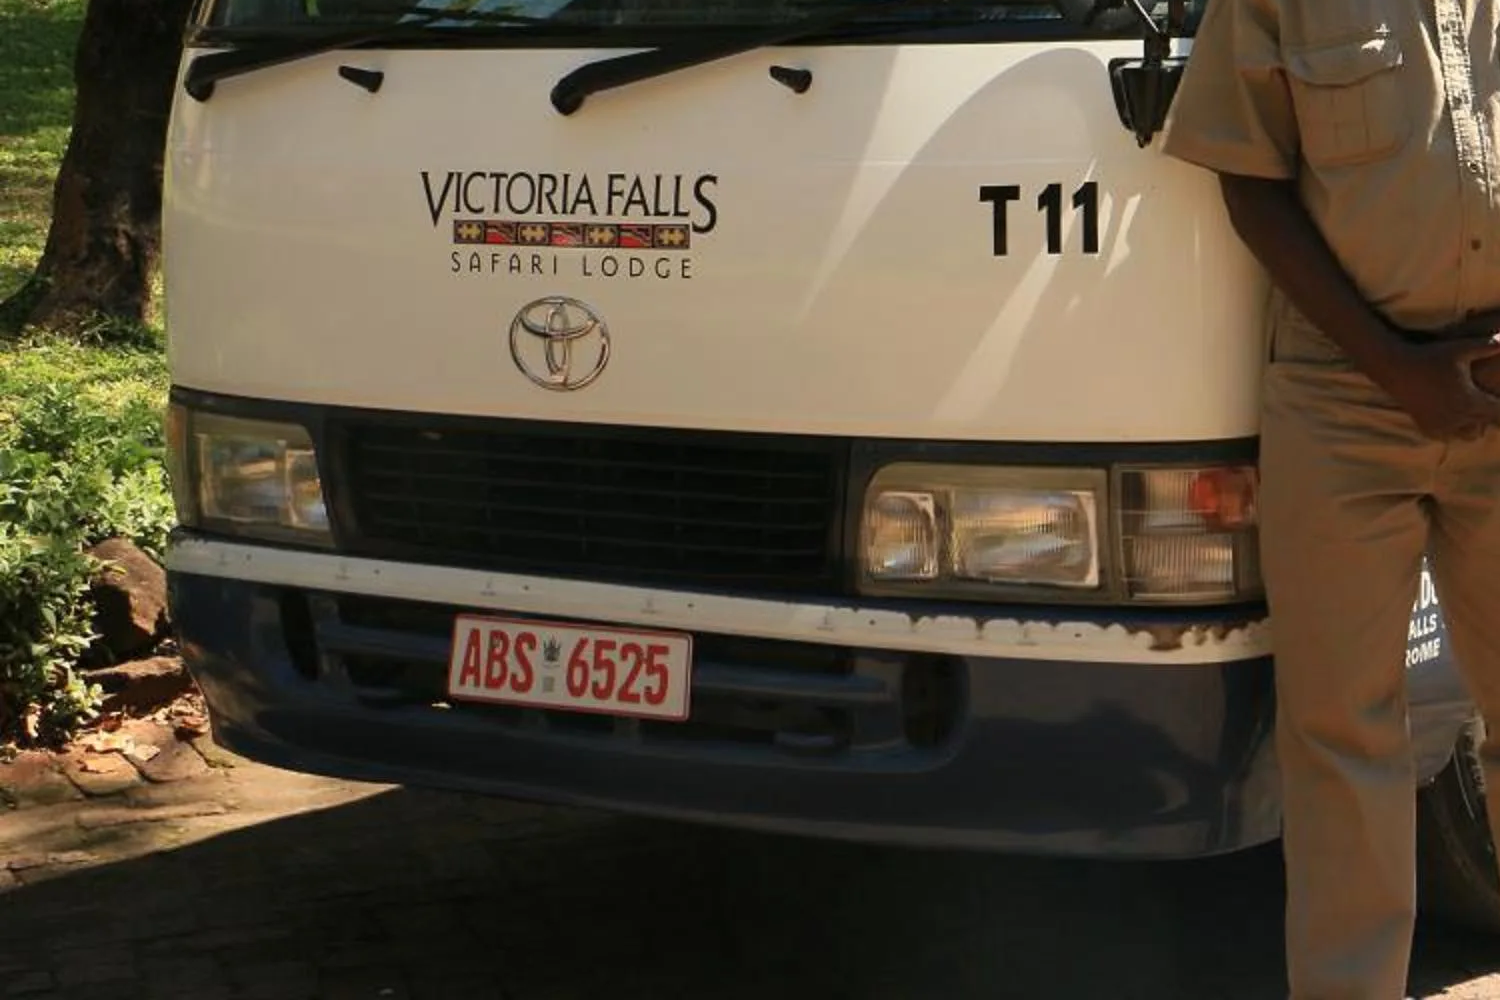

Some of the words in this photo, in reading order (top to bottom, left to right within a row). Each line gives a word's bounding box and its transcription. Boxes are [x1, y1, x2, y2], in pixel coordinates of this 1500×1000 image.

[421, 171, 598, 228] VICTORIA
[606, 173, 719, 234] FALLS
[978, 185, 1021, 257] T
[1037, 181, 1098, 255] 11
[451, 251, 557, 276] SAFARI
[582, 255, 693, 279] LODGE
[1407, 612, 1438, 641] ALLS
[459, 627, 537, 693] ABS
[566, 637, 670, 706] 6525
